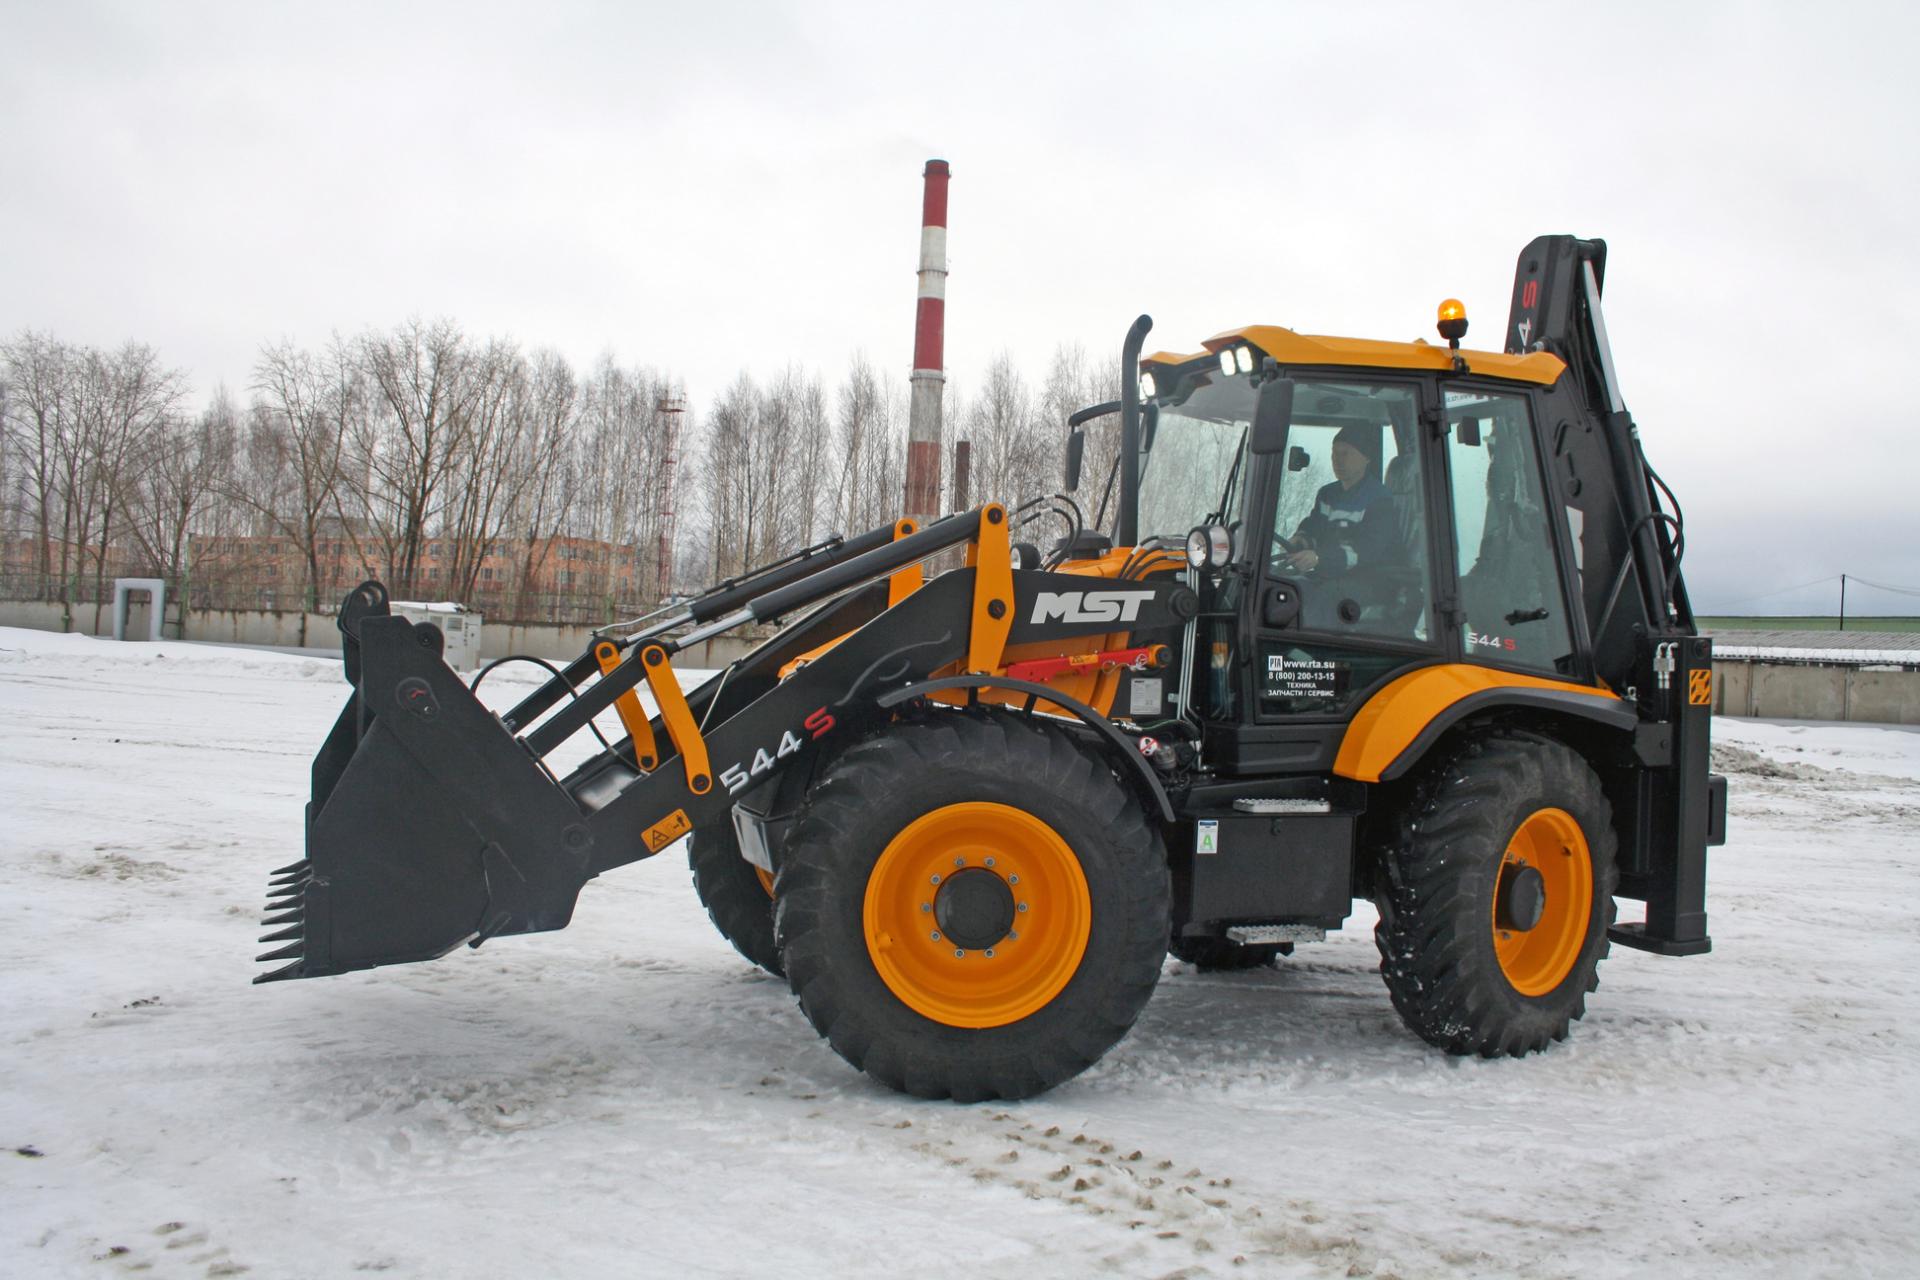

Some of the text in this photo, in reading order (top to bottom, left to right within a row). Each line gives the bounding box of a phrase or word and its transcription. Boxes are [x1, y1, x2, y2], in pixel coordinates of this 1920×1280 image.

[1522, 280, 1538, 309] S
[1030, 590, 1156, 624] MST
[1467, 632, 1516, 651] 544 S
[1268, 672, 1335, 681] 8 (800) 200-13-15
[1284, 660, 1335, 669] www.rta.su
[718, 705, 836, 797] 544 S
